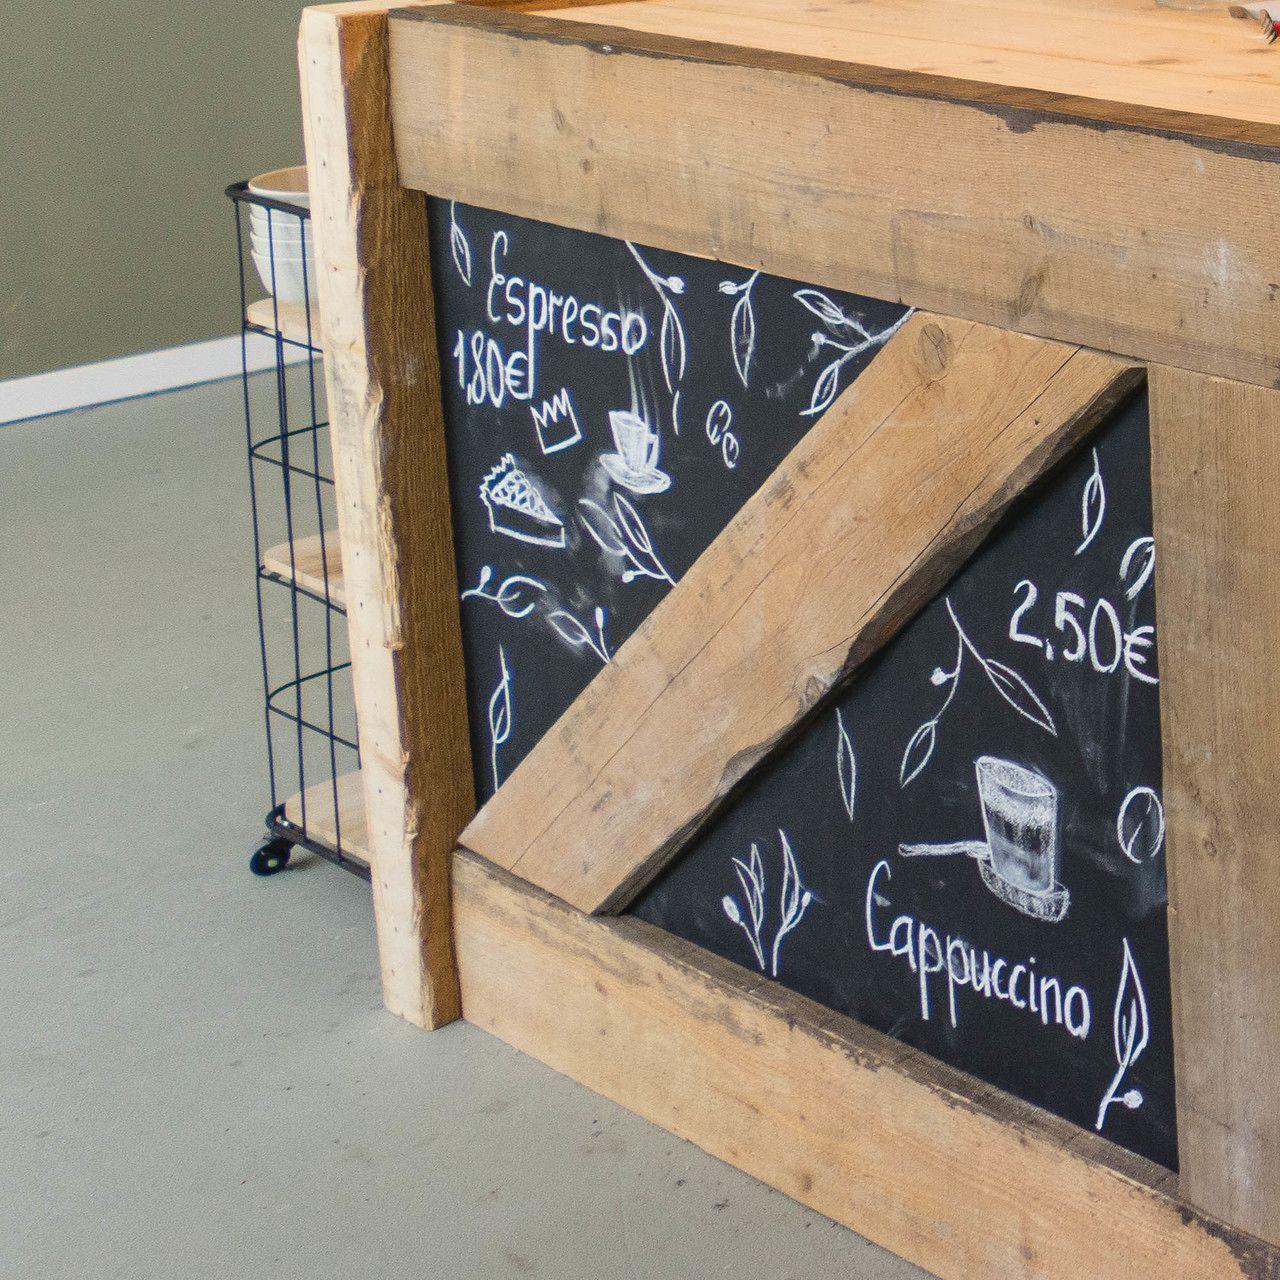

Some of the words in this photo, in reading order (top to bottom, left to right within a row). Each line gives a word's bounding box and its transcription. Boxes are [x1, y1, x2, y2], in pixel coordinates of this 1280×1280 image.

[486, 230, 648, 400] Espresso
[1008, 580, 1160, 684] 2,50€
[865, 859, 1092, 1040] Cappuccino
